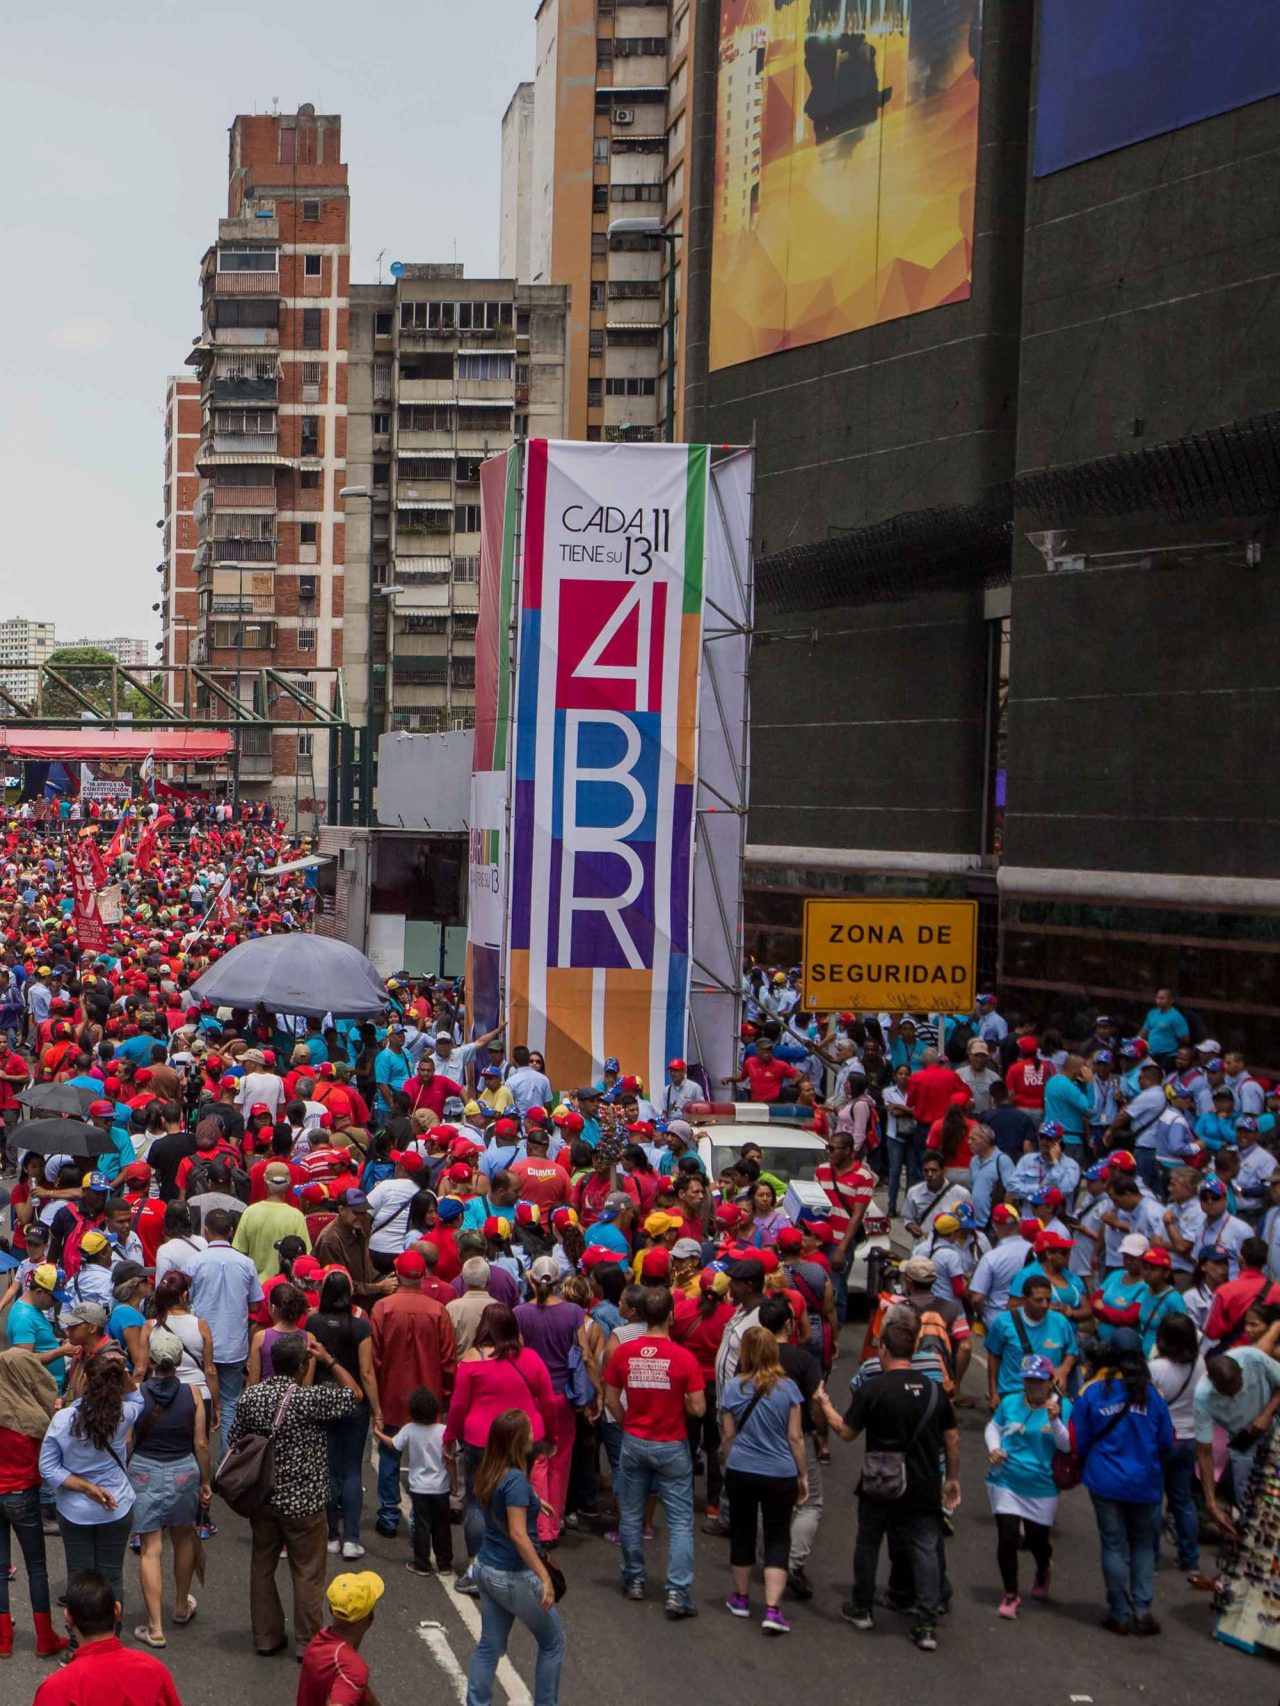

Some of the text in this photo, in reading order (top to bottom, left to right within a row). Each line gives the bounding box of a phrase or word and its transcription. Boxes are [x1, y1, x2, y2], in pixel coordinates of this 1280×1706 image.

[562, 505, 669, 552] CADA 11
[559, 536, 653, 575] TIENE SU 13
[829, 925, 952, 944] ZONA DE
[811, 964, 967, 983] SEGURIDAD
[1024, 1077, 1044, 1086] VOZ
